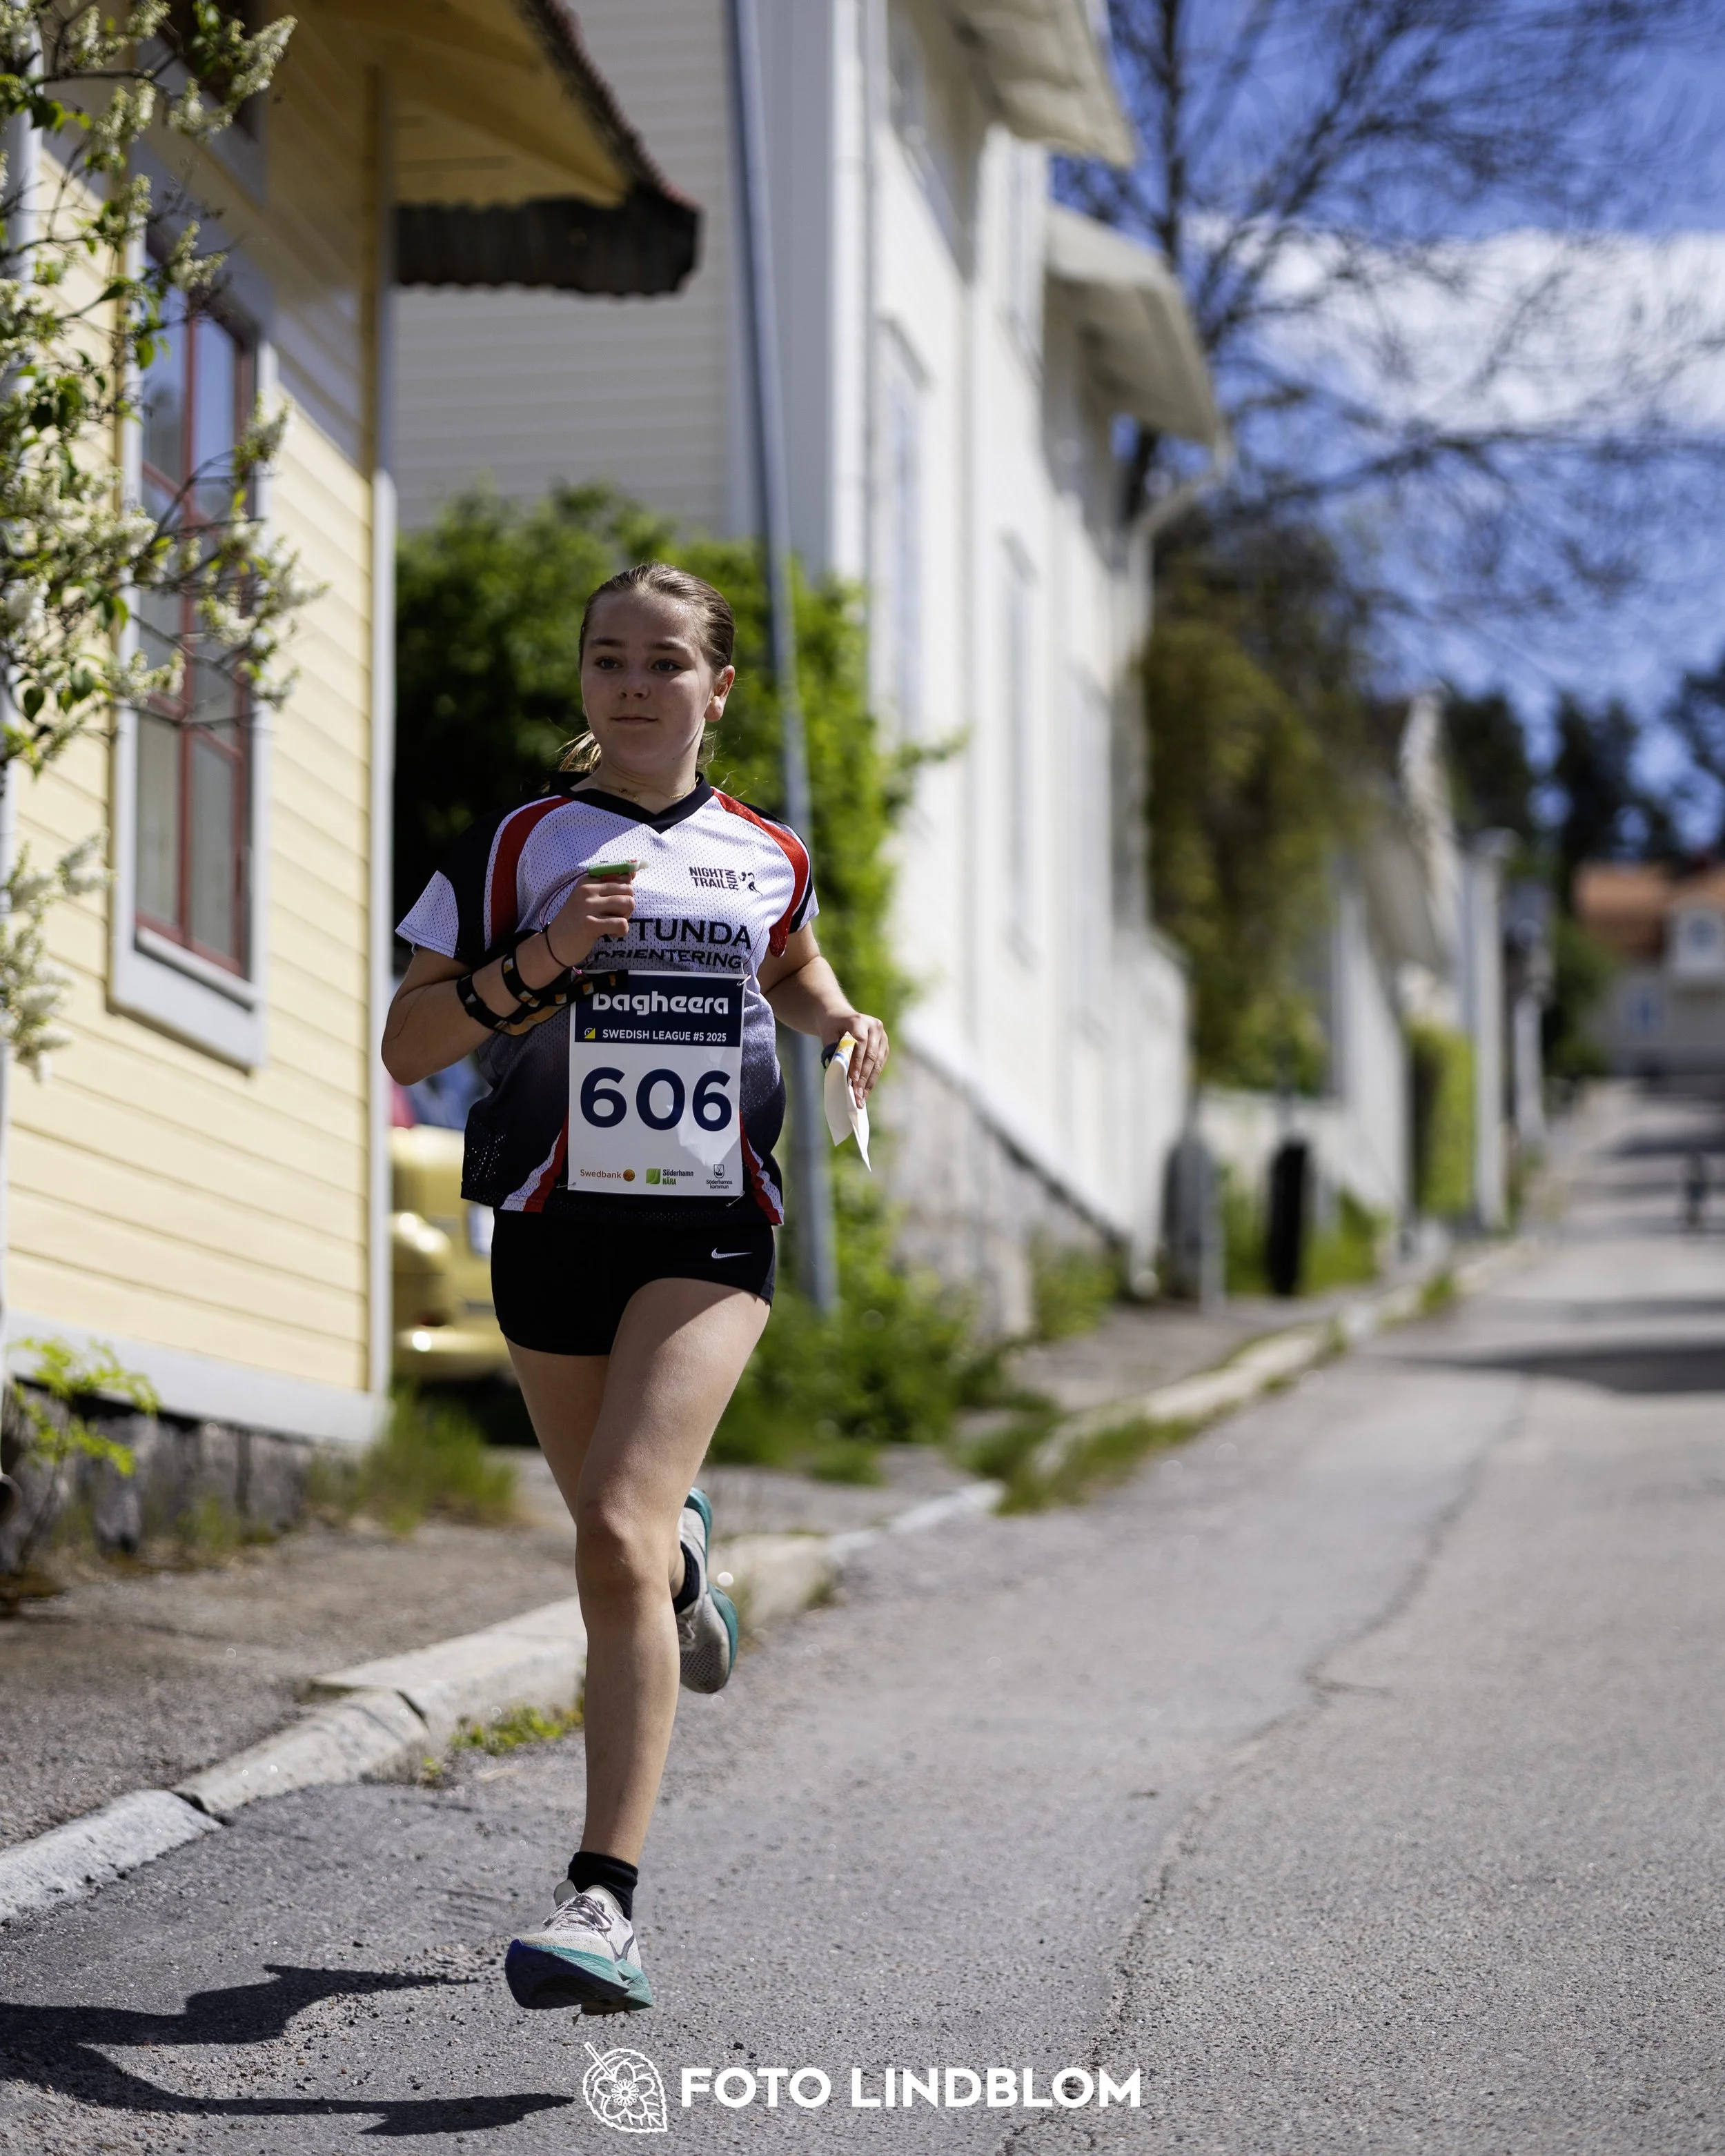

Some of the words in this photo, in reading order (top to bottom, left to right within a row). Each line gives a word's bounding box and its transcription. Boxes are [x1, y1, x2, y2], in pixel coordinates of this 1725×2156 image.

[689, 867, 723, 878] NIGHT
[692, 877, 728, 889] TRAIL
[724, 869, 738, 890] RUN
[598, 918, 751, 950] TUNDA
[593, 991, 729, 1015] bagheera
[602, 1029, 649, 1039] SWEDISH
[653, 1031, 691, 1041] LEAGUE
[693, 1032, 704, 1041] #5
[707, 1033, 727, 1042] 2025
[580, 1066, 732, 1132] 606
[580, 1169, 621, 1179] Swedbank
[662, 1169, 694, 1177] Söderhamn
[662, 1177, 677, 1185] NÄRA
